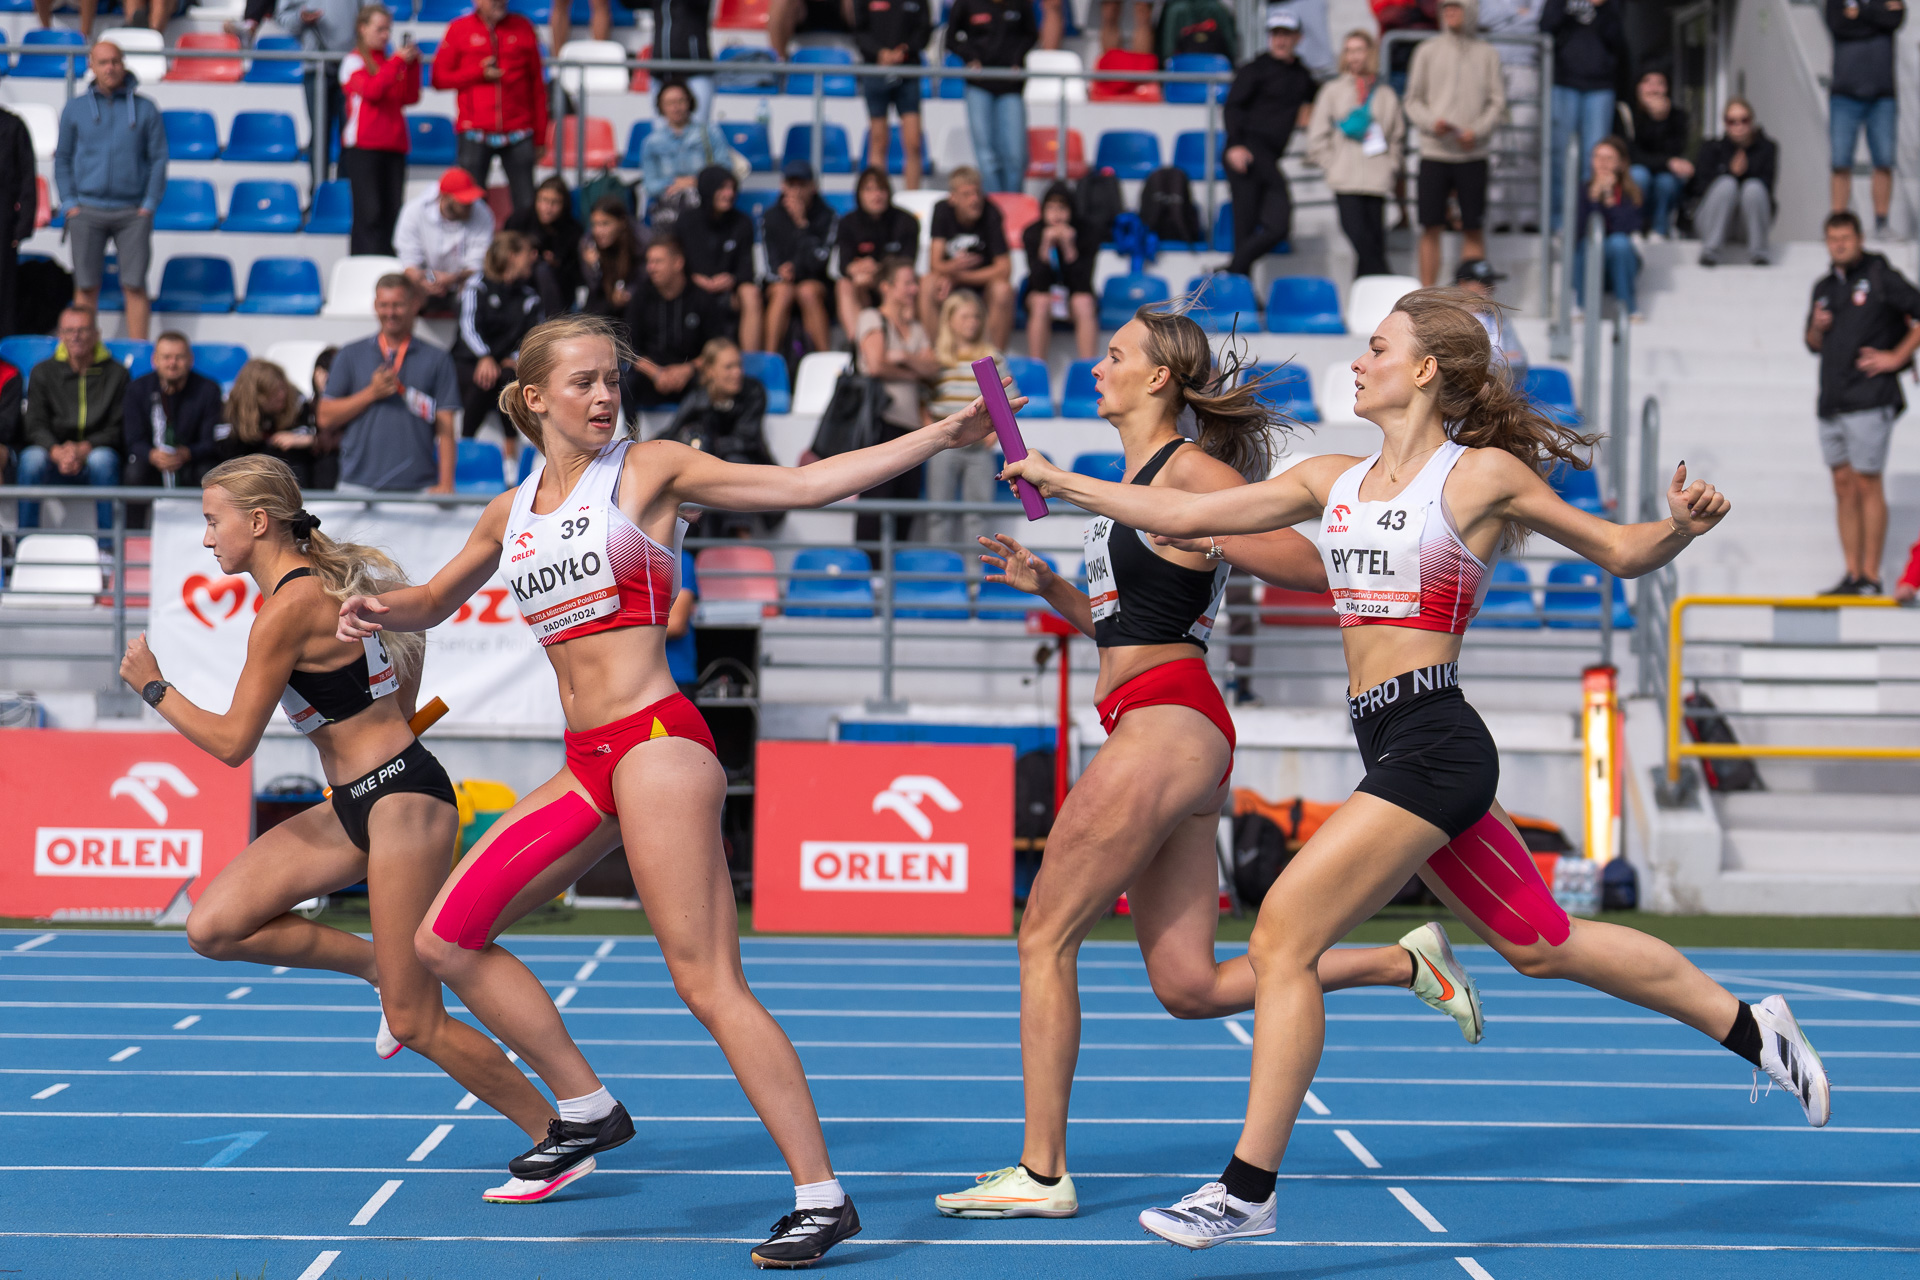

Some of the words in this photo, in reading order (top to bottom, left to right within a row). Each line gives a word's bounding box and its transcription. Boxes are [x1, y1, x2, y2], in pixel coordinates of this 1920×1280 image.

[560, 516, 590, 540] 39
[1092, 519, 1110, 543] 346
[1326, 525, 1349, 533] ORLEN
[1376, 509, 1407, 531] 43
[511, 548, 536, 563] ORLEN
[1330, 548, 1395, 576] PYTEL
[510, 551, 601, 602] KADYŁO
[546, 601, 577, 618] Mistrzostwa
[577, 595, 594, 606] Polski
[593, 590, 608, 600] U20
[1361, 603, 1390, 614] 2024
[1373, 593, 1394, 602] Polski
[1395, 593, 1409, 602] U20
[543, 615, 572, 633] RADOM
[572, 607, 596, 622] 2024
[350, 775, 378, 799] NIKE
[378, 758, 406, 785] PRO
[47, 838, 189, 867] ORLEN
[814, 852, 953, 881] ORLEN
